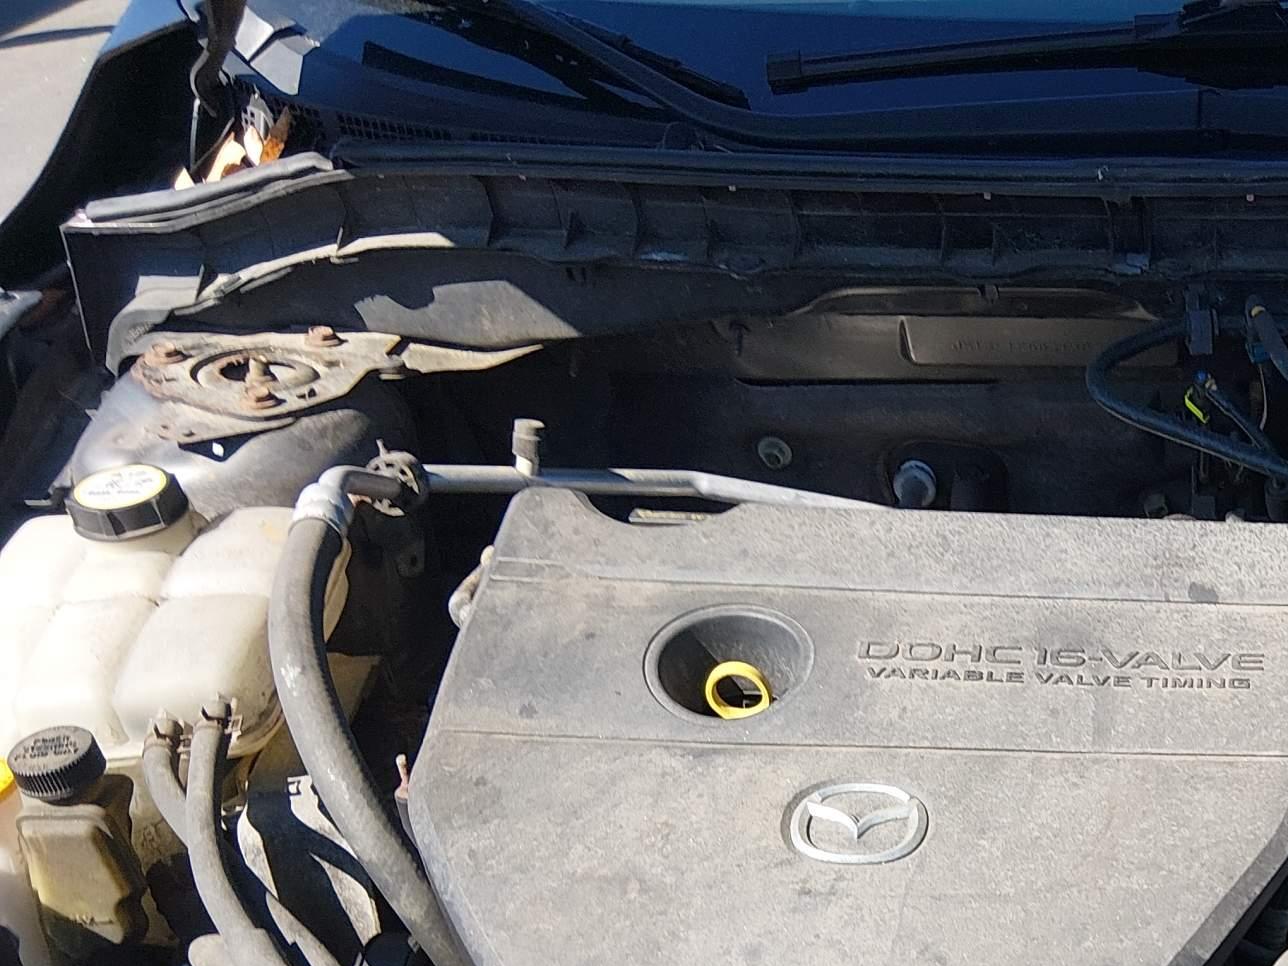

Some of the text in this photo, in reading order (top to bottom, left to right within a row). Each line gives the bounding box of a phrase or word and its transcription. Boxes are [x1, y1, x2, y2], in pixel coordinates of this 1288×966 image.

[857, 640, 1266, 672] DOHC 16-VALVE
[866, 666, 1252, 690] VARIABLE VALVE TIMING
